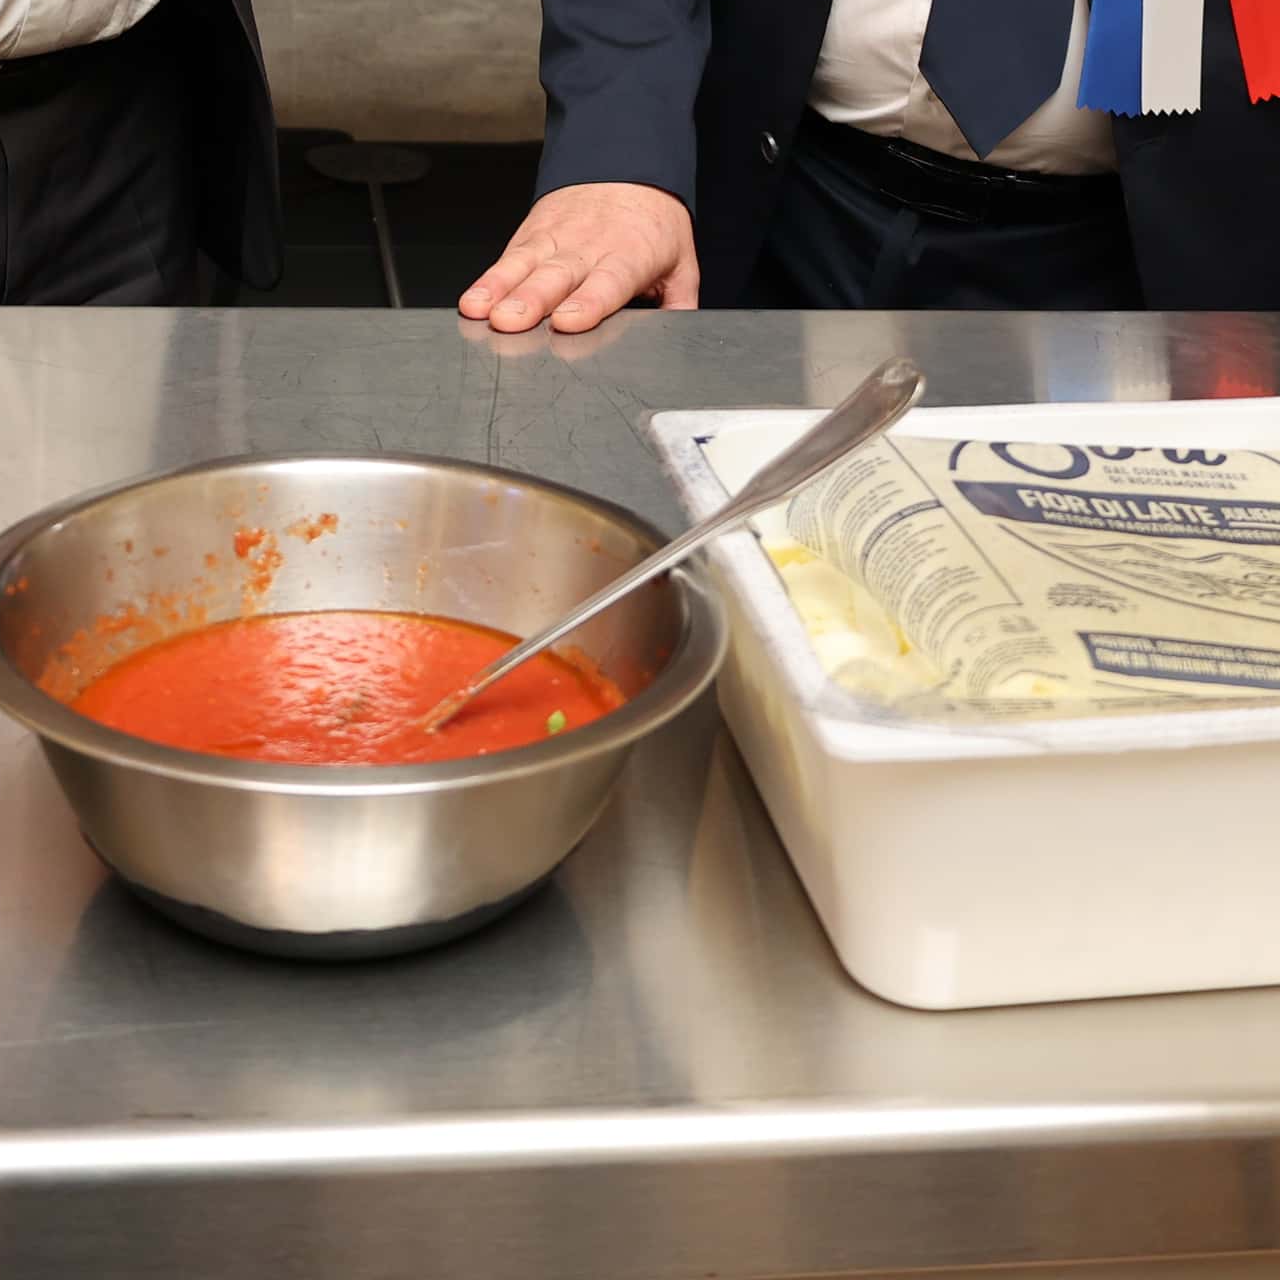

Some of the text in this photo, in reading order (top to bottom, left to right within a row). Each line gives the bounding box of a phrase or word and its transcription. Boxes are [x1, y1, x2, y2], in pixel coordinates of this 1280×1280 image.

[1016, 489, 1092, 515] FIOR
[1090, 497, 1129, 520] DI
[1126, 499, 1220, 526] LATTE
